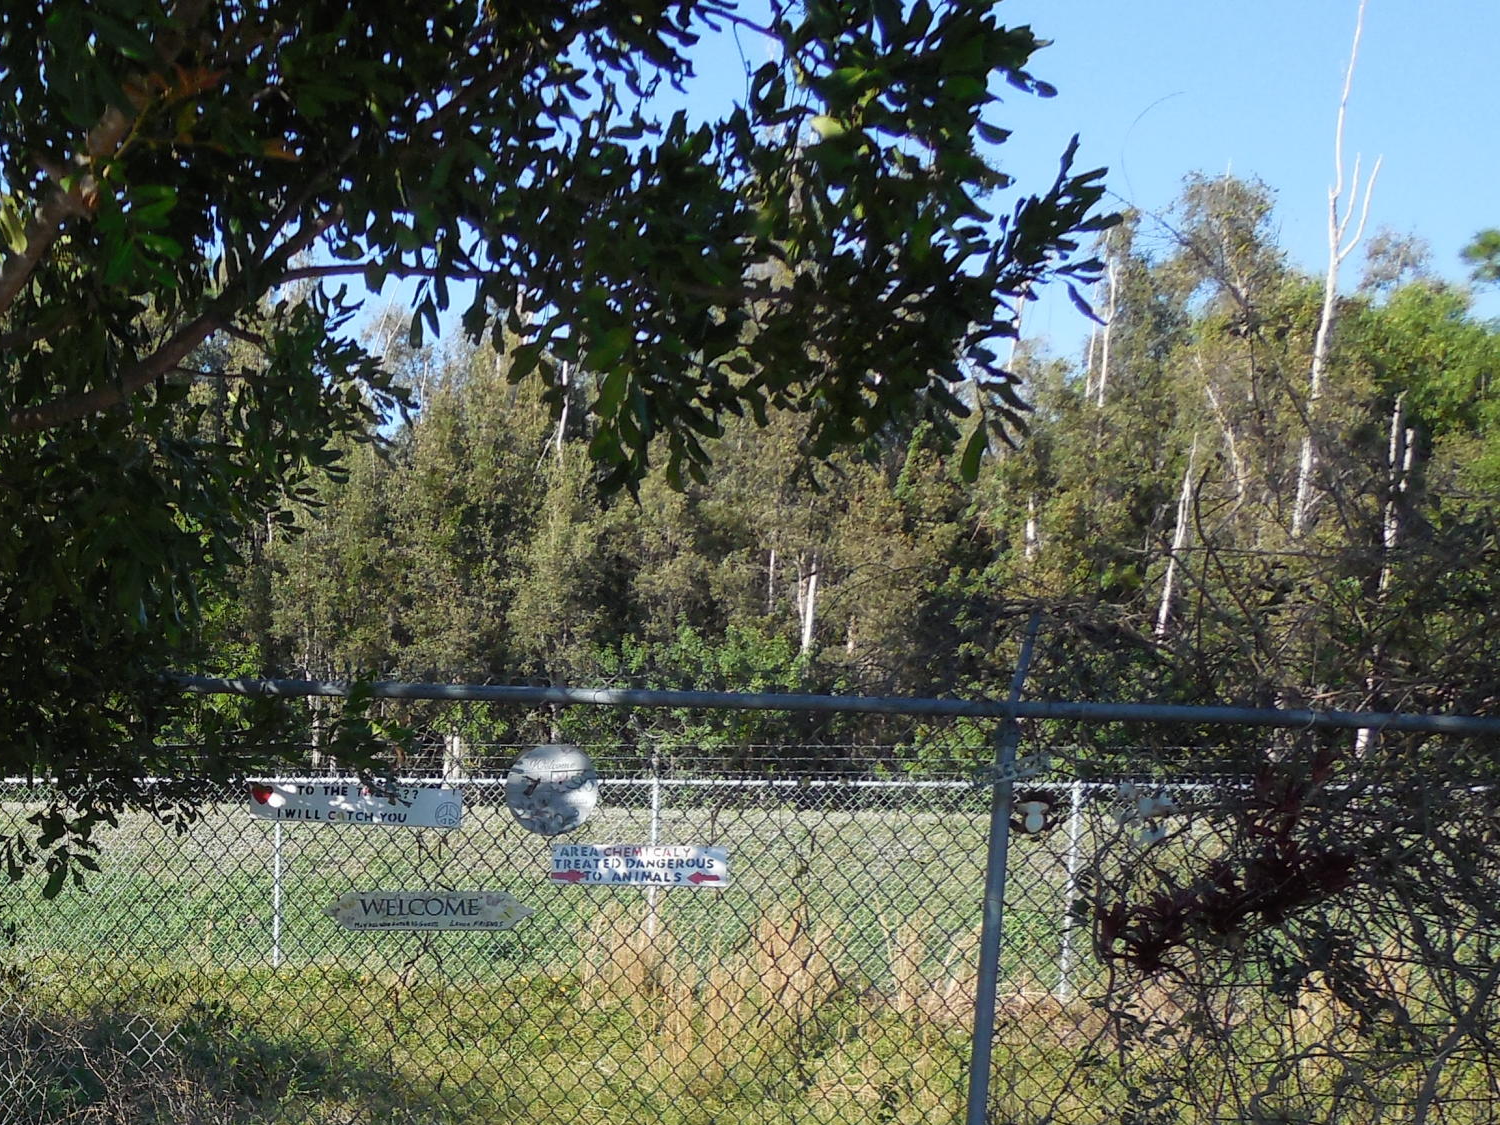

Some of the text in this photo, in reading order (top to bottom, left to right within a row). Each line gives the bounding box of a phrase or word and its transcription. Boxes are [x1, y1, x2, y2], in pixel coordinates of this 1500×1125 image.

[299, 785, 315, 796] TO
[324, 785, 348, 797] THE
[277, 808, 408, 824] I WILL CATCH YOU
[560, 846, 600, 857] AREA
[554, 858, 714, 869] TREATED DANGEROUS
[584, 870, 682, 883] TO ANIMALS
[359, 897, 480, 917] WELCOME
